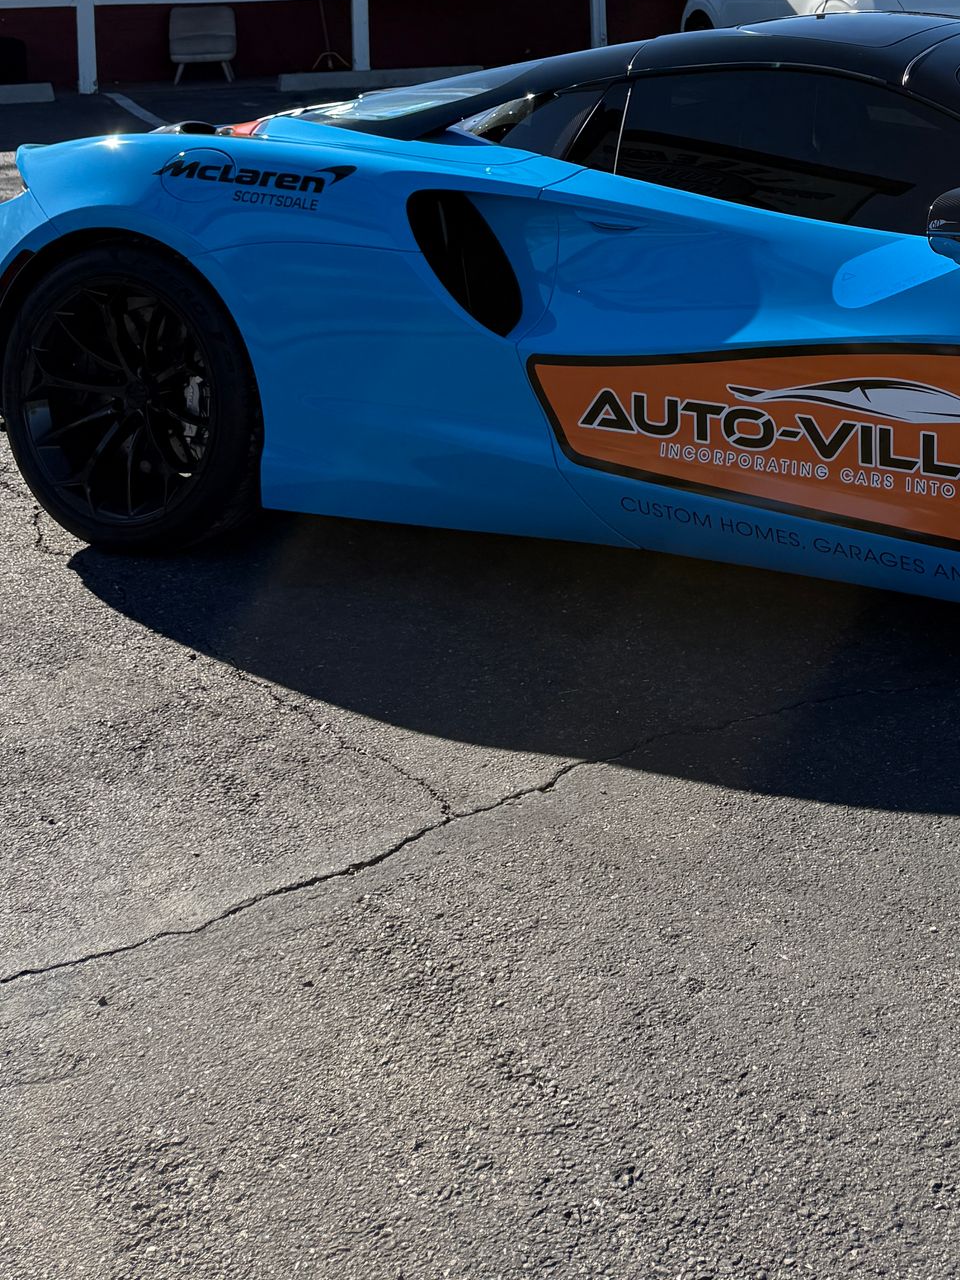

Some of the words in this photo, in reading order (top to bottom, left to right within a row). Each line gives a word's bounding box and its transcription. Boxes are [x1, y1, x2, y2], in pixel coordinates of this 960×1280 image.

[152, 160, 326, 193] McLaren
[233, 190, 319, 211] SCOTTSDALE
[660, 442, 829, 480] INCORPORATING
[840, 467, 894, 490] CARS
[906, 477, 957, 499] INTO
[620, 495, 713, 529] CUSTOM
[813, 537, 926, 575] GARAGES
